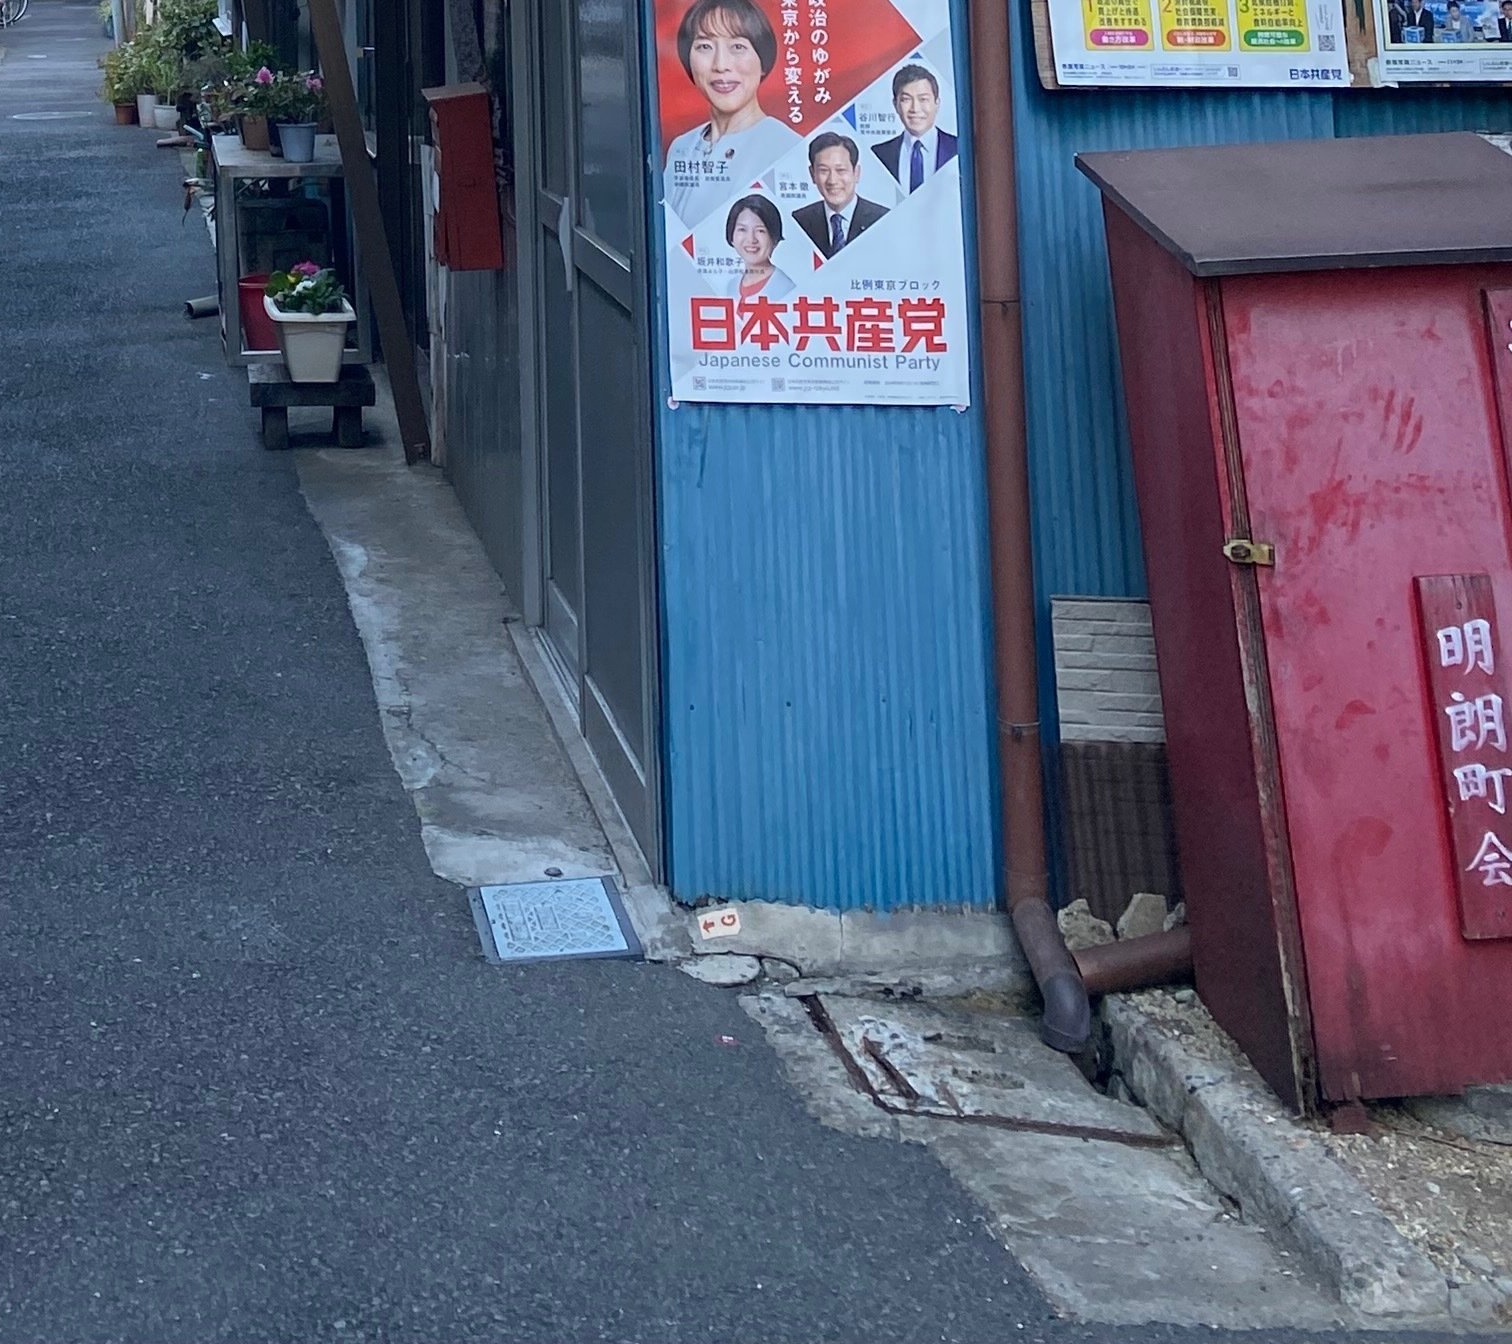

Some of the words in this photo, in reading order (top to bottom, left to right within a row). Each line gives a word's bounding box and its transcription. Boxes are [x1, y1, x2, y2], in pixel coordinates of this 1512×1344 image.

[1289, 68, 1343, 81] 日本共産党
[674, 160, 729, 175] 田村智子
[850, 279, 941, 291] 比例東京ブロック
[691, 296, 947, 353] 日本共産党
[699, 352, 781, 370] Japanese
[788, 353, 889, 369] Communist
[896, 354, 941, 372] Party
[1436, 618, 1512, 886] 明朗町会
[721, 914, 736, 926] G
